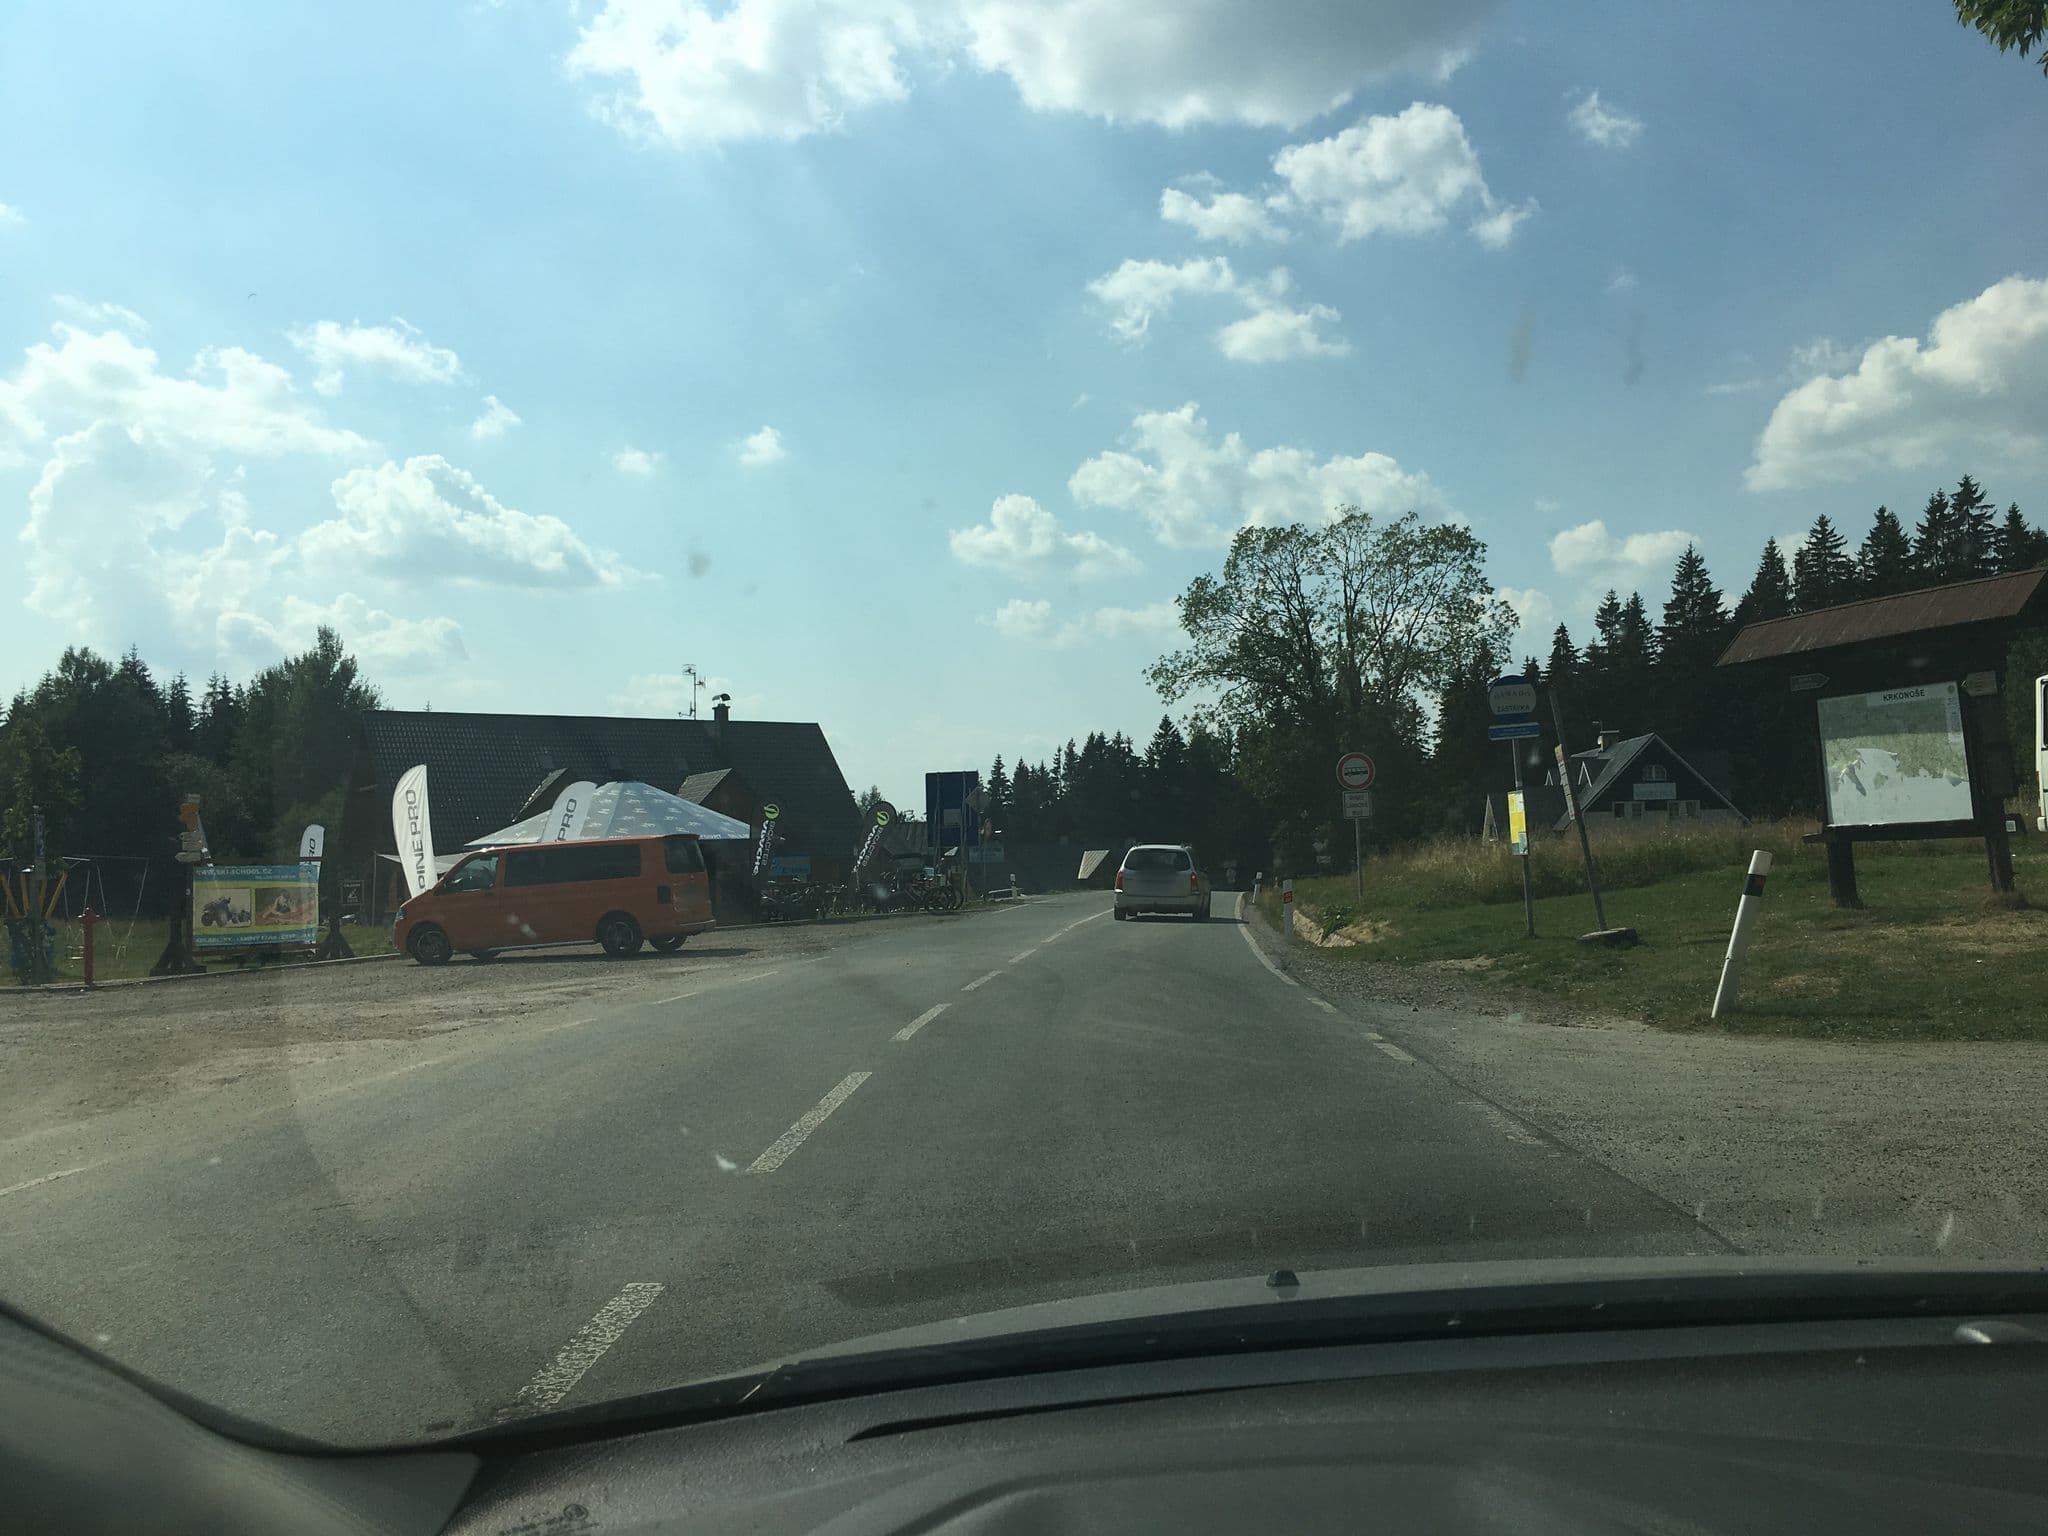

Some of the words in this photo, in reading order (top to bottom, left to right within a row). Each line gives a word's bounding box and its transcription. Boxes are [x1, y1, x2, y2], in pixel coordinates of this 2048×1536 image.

[1883, 688, 1925, 701] KRKONOŠE
[406, 789, 420, 836] PRO
[557, 798, 577, 841] PRO
